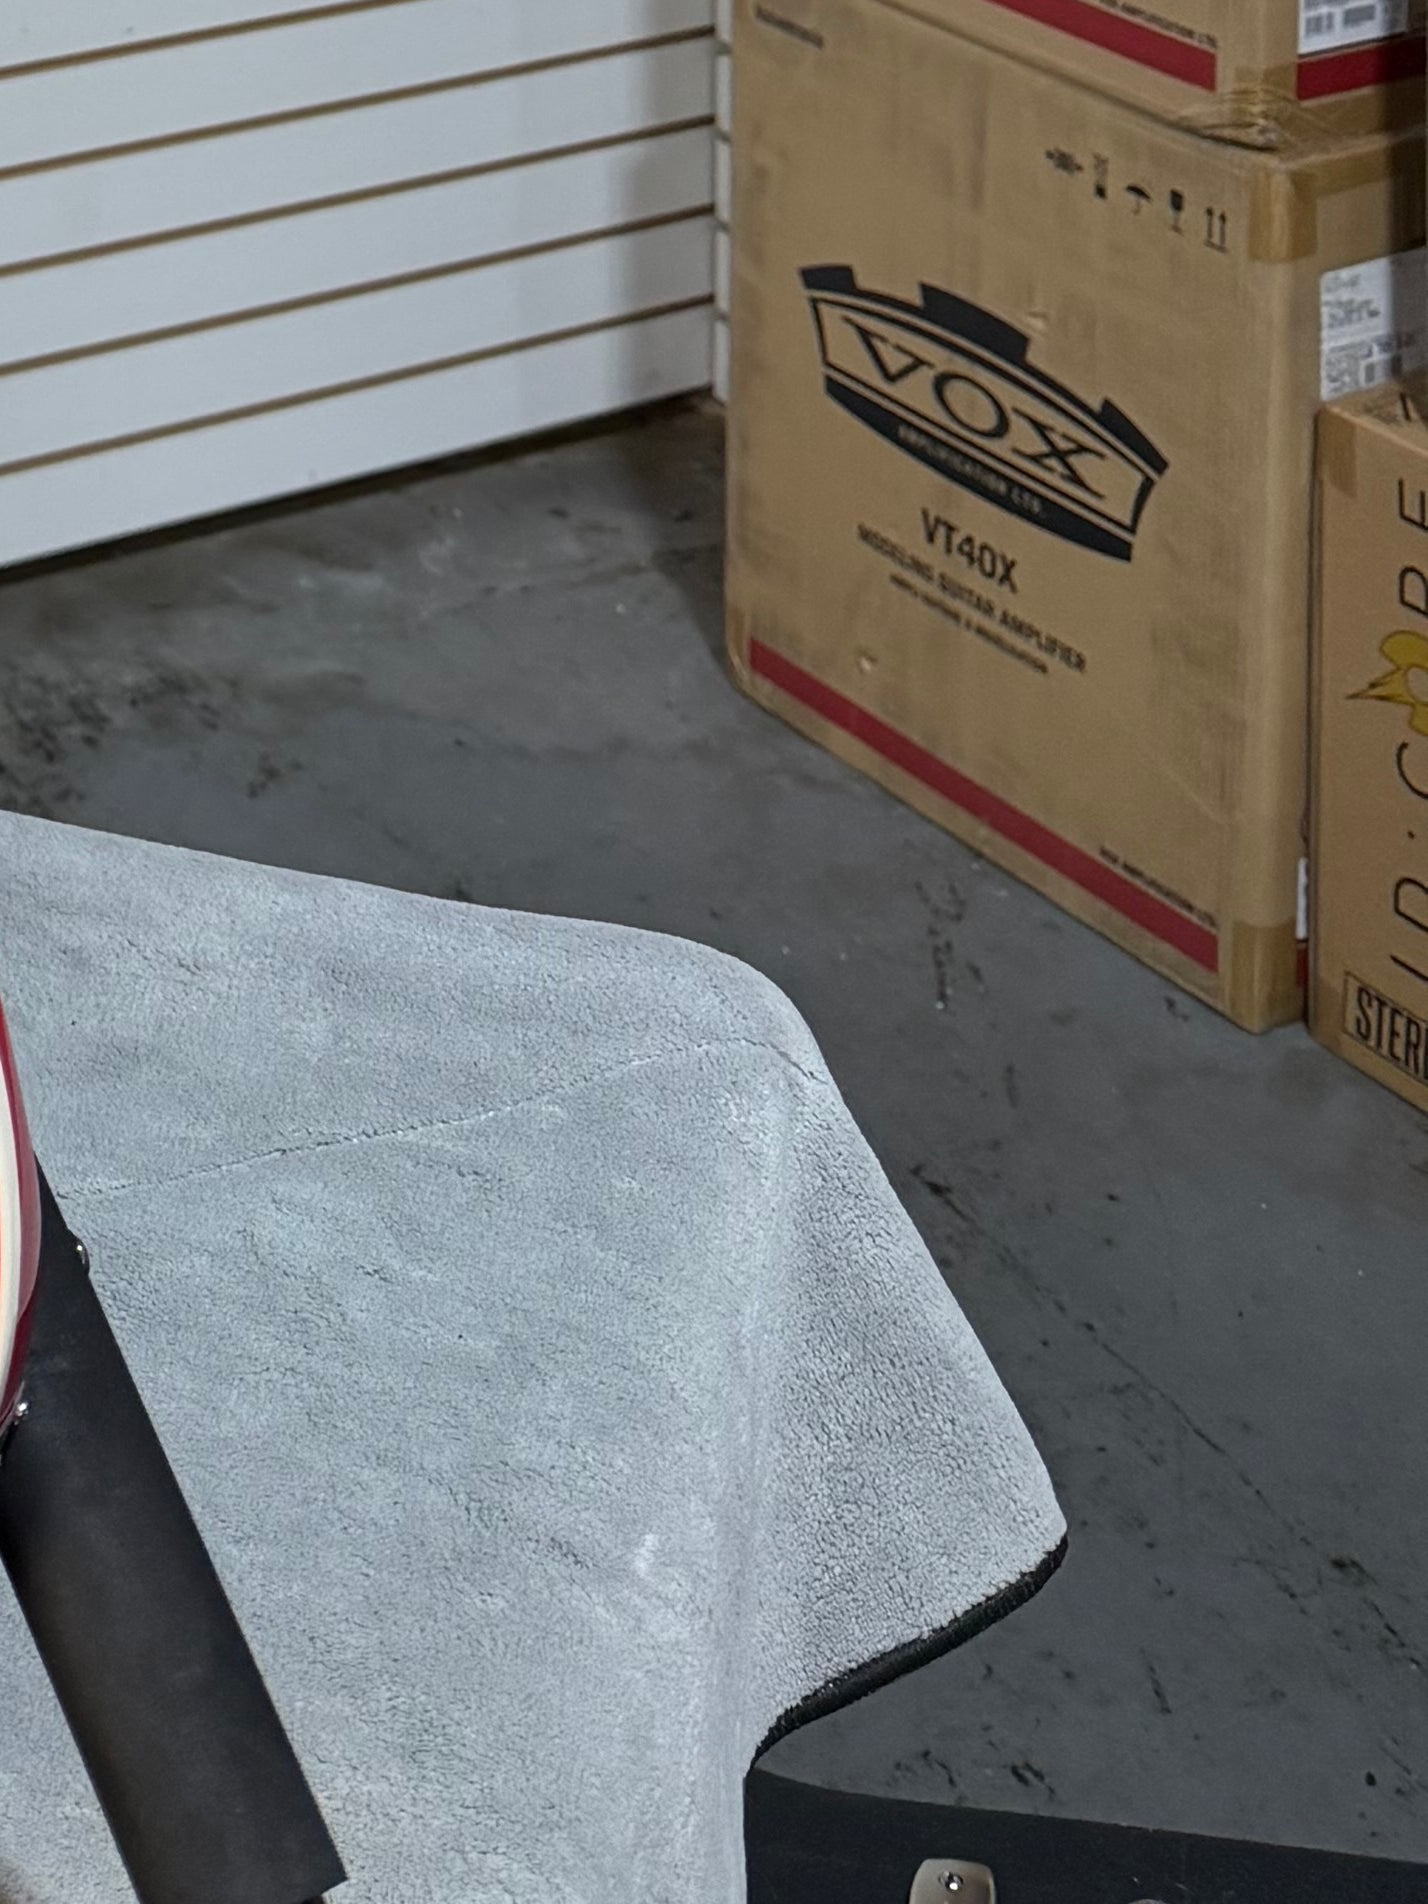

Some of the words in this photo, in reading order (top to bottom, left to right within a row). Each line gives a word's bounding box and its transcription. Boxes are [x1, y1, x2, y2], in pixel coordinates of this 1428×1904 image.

[842, 314, 1109, 501] VOX
[921, 506, 1020, 595] VT40X
[999, 607, 1088, 675] AMPLIFIER
[1354, 985, 1428, 1082] STER
